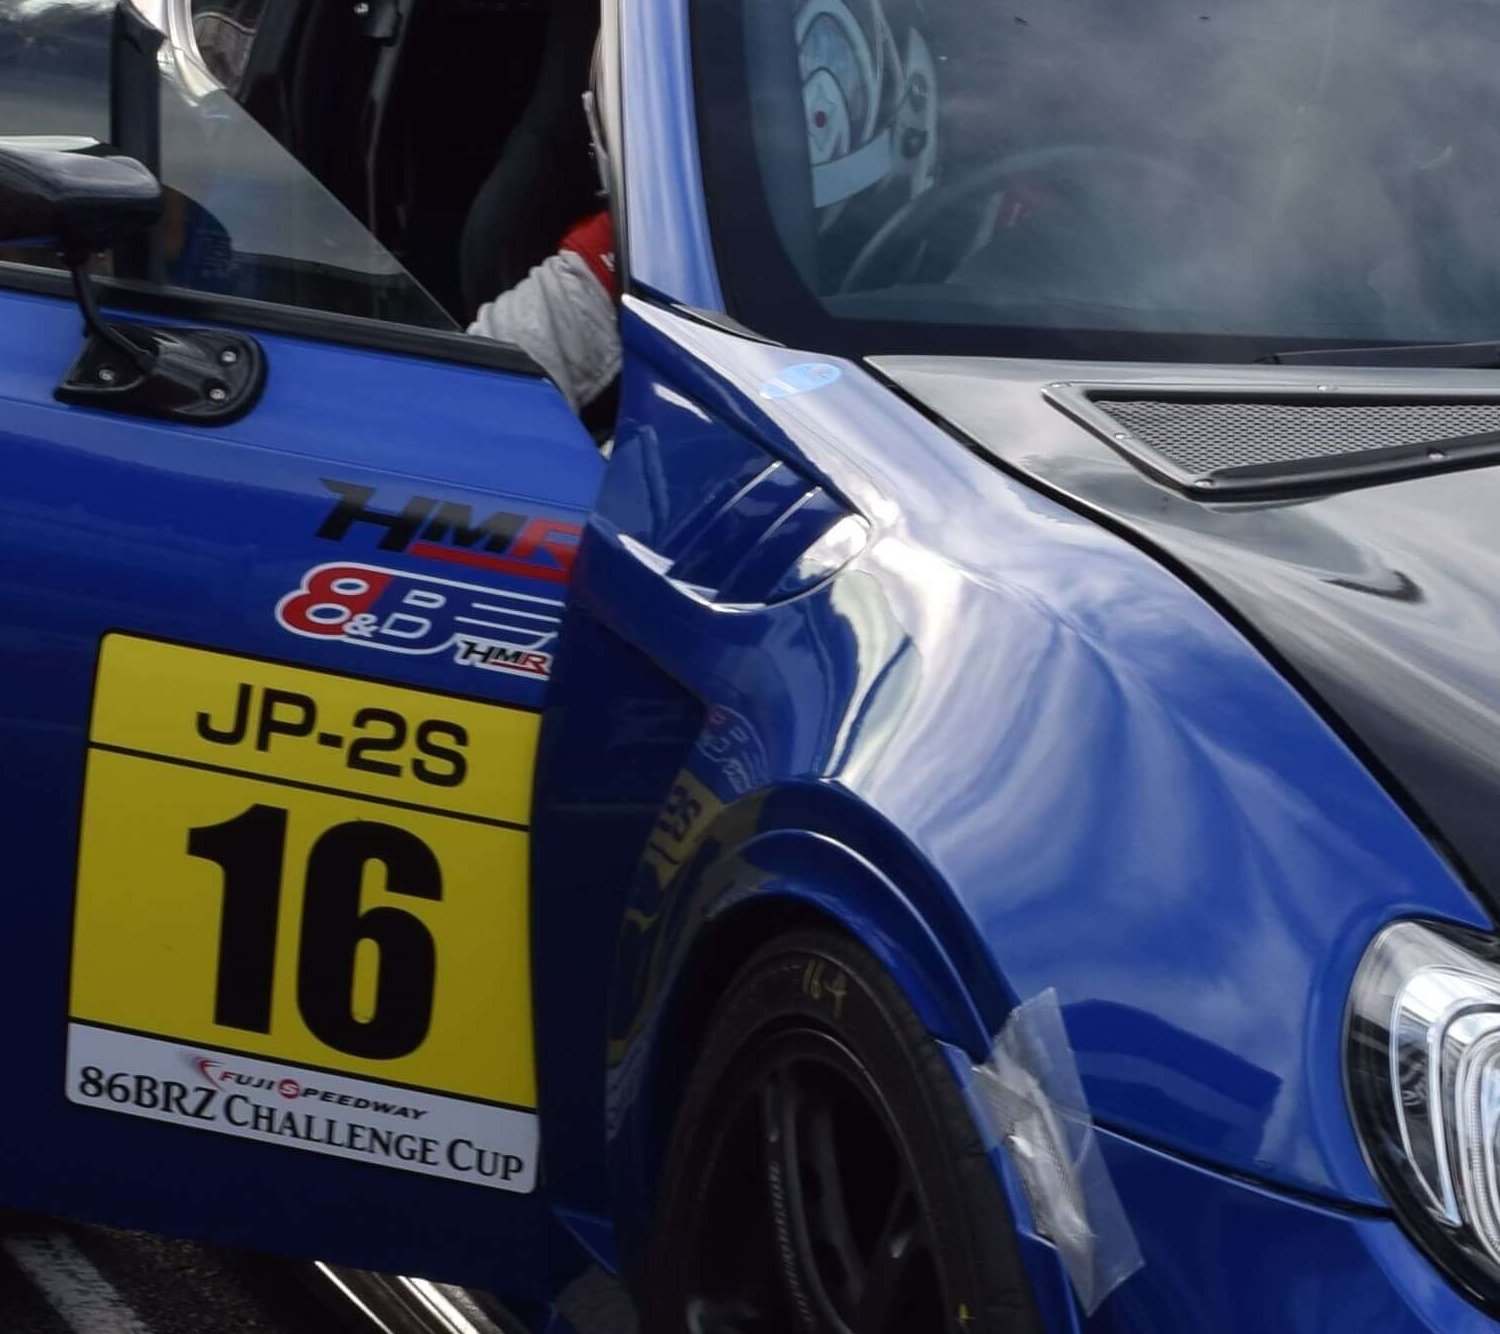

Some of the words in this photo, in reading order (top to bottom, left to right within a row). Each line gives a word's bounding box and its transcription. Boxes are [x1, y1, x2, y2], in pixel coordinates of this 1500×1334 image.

[460, 639, 550, 676] HMR
[195, 682, 470, 788] JP-2S
[185, 802, 445, 1061] 16
[77, 1065, 217, 1122] 86BRZ
[223, 1093, 441, 1167] CHALLENGE
[445, 1138, 525, 1183] CUP
[220, 1069, 277, 1090] FUJI
[277, 1078, 429, 1122] SPEEDWAY
